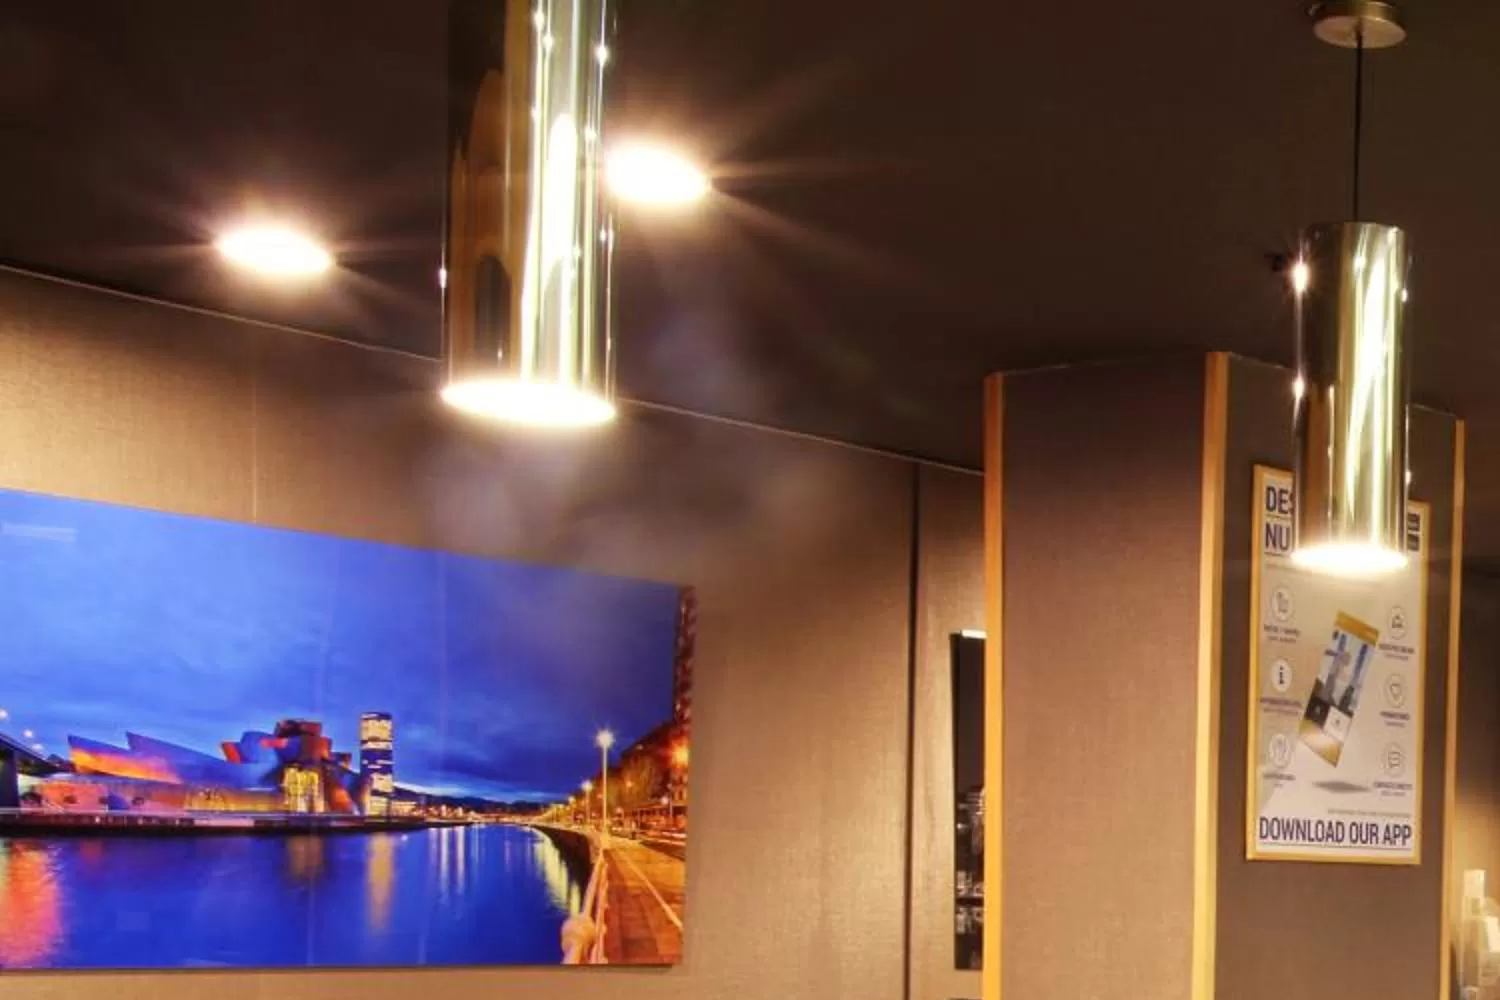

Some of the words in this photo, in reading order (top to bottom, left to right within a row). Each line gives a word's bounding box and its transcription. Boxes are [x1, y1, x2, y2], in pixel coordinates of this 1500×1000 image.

[1259, 817, 1345, 843] DOWNLOAD
[1349, 822, 1379, 845] OUR
[1382, 824, 1412, 846] APP
